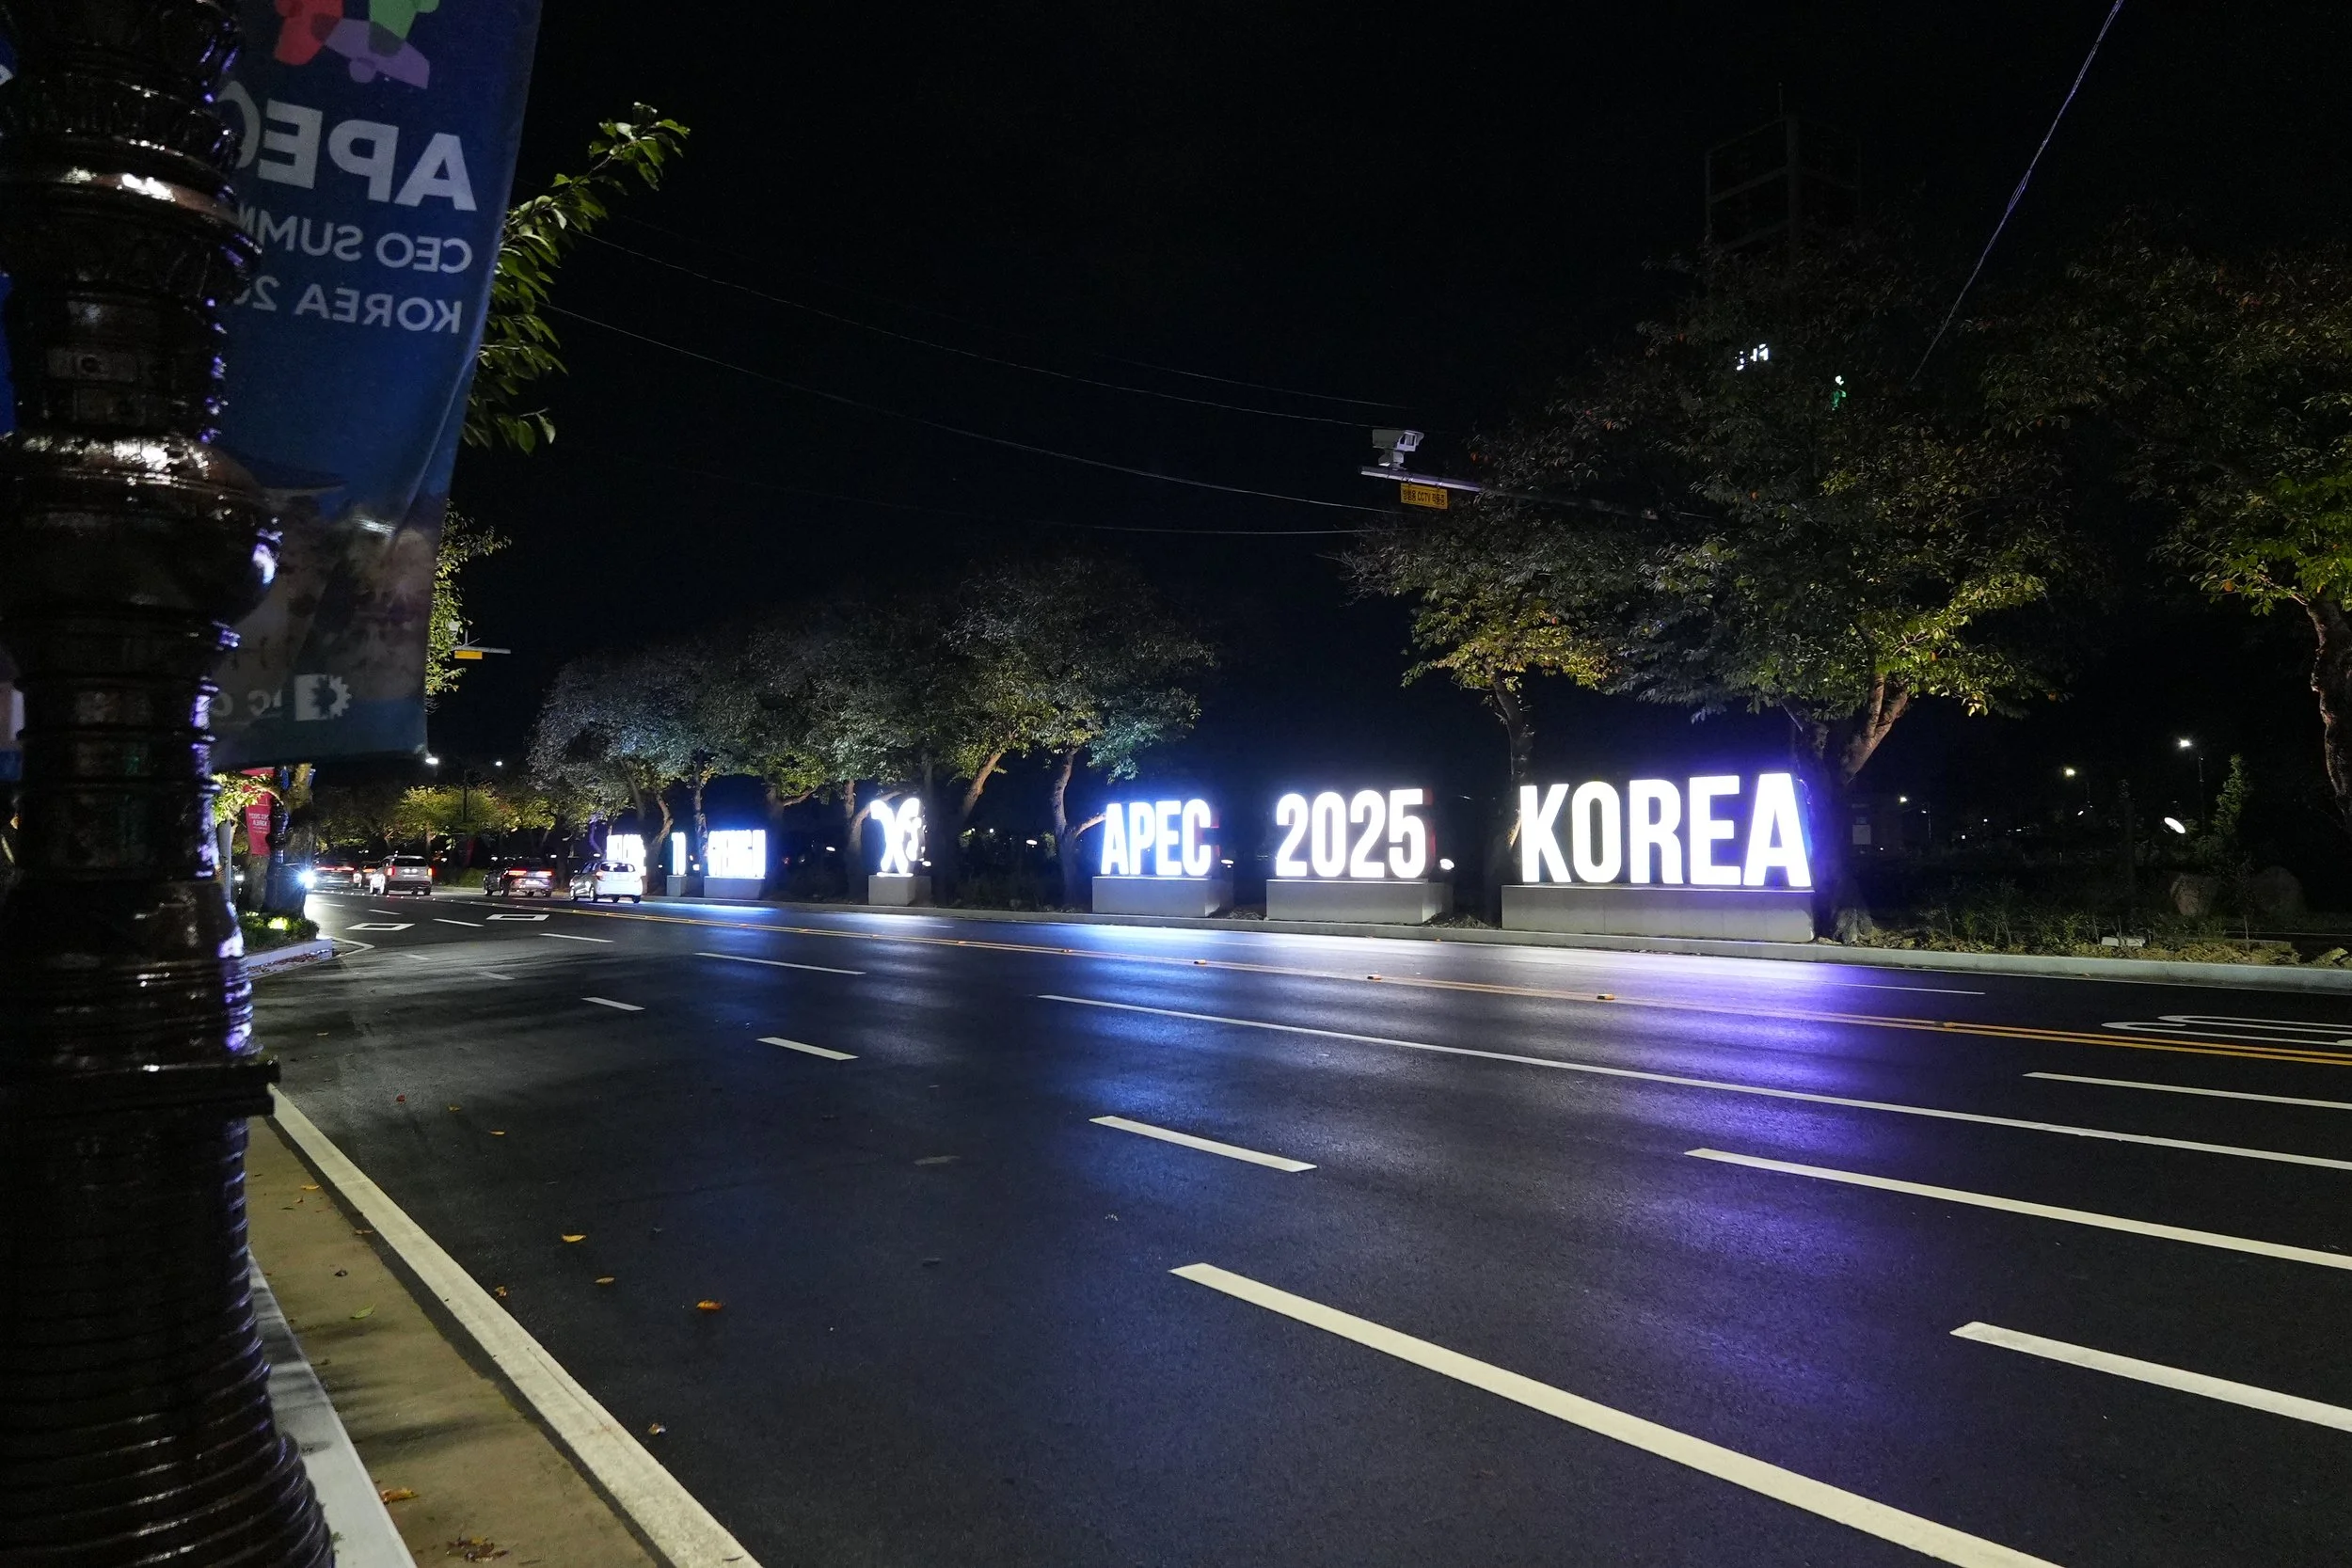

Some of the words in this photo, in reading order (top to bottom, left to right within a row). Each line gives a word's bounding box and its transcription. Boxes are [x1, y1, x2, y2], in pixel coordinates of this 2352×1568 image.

[1418, 491, 1430, 502] CCTV
[1101, 799, 1212, 877] APEC
[1275, 788, 1426, 879] 2025
[1519, 772, 1812, 887] KOREA
